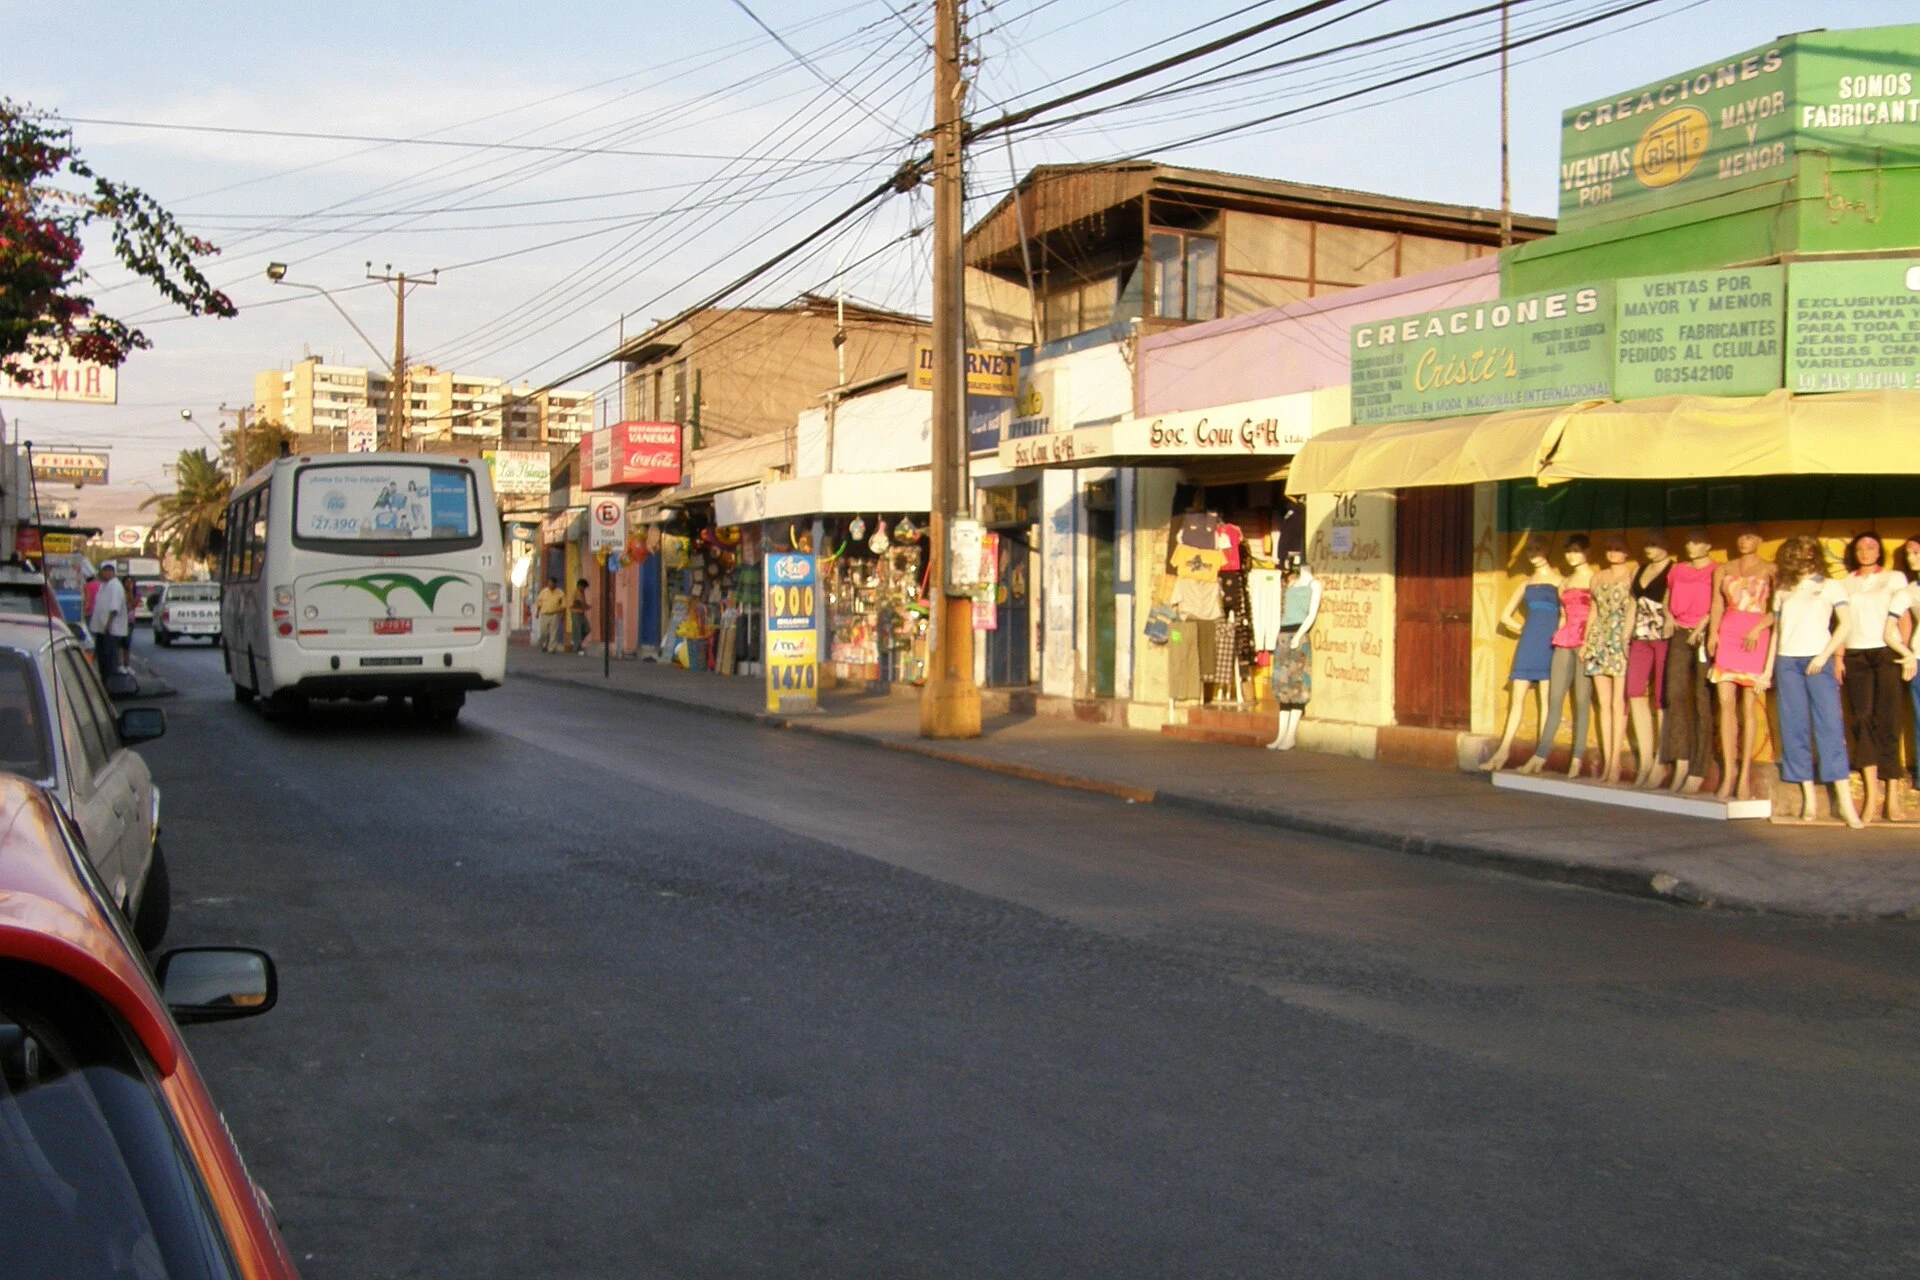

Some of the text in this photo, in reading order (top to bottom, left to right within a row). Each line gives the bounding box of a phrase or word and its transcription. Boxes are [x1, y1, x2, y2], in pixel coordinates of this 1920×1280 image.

[1574, 48, 1783, 132] CREACIONES
[1839, 72, 1912, 99] SOMOS
[1720, 90, 1786, 130] MAYOR
[1745, 124, 1758, 146] Y
[1562, 147, 1631, 191] VENTAS
[1719, 142, 1786, 180] MENOR
[1578, 182, 1613, 208] POR
[1643, 275, 1752, 298] VENTAS POR
[1624, 292, 1773, 317] MAYOR Y MENOR
[1797, 310, 1847, 321] PARA
[1853, 309, 1905, 320] DAMA
[1356, 287, 1598, 350] CREACIONES
[1797, 323, 1846, 333] PARA
[1852, 321, 1900, 332] TODA
[1619, 319, 1777, 346] SOMOS FABRICANTES
[1796, 333, 1858, 345] JEANS
[1619, 339, 1778, 364] PEDIDOS AL CELULAR
[1796, 346, 1871, 357] BLUSAS
[1796, 357, 1916, 368] VARIEDADES
[1414, 346, 1518, 393] Cristi's
[1654, 364, 1735, 384] 083542106
[1525, 381, 1610, 403] INTERNACIONAL
[629, 433, 676, 445] VANESSA
[602, 505, 613, 521] E
[1333, 493, 1358, 519] 716
[481, 555, 493, 567] 11
[774, 585, 815, 617] 900
[771, 664, 815, 691] 1470
